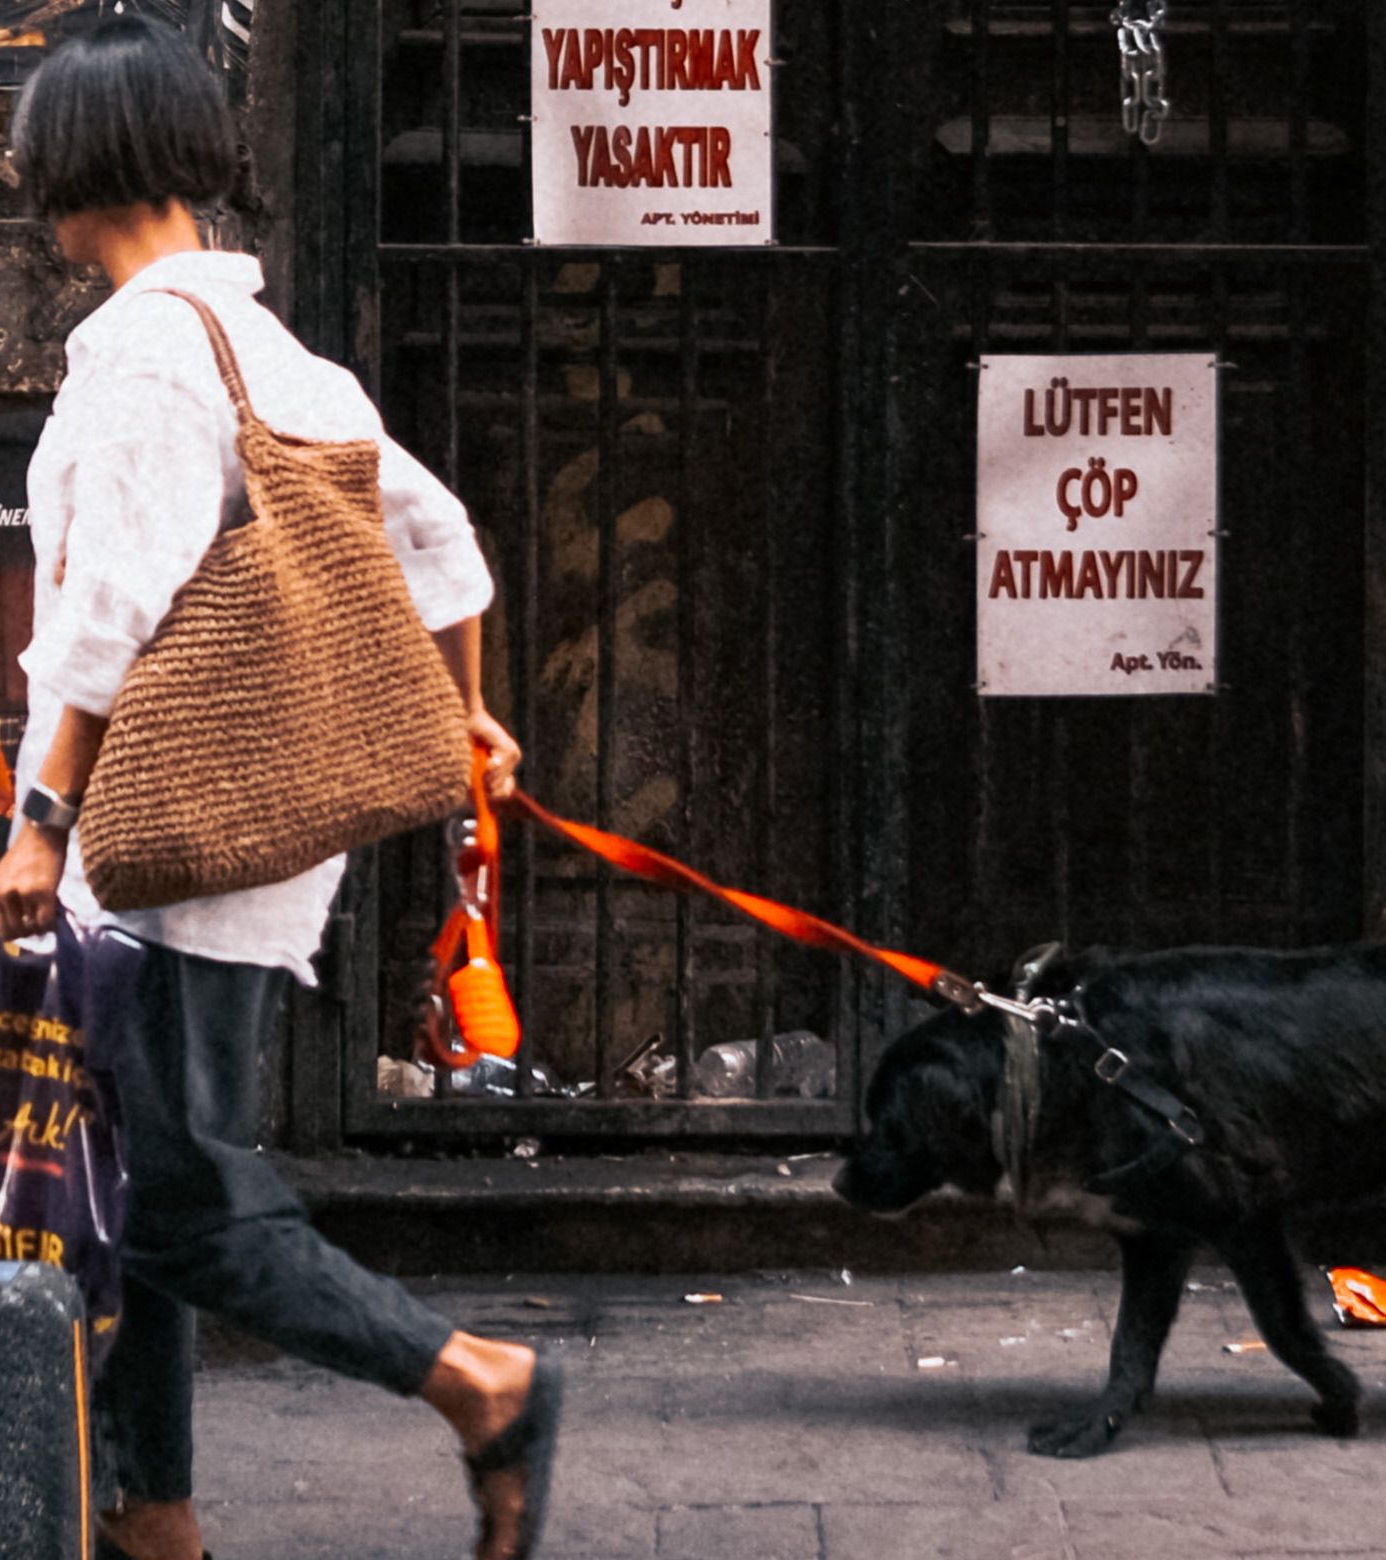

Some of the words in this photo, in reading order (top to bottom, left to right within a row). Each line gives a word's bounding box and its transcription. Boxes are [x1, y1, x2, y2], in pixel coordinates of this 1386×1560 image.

[541, 28, 762, 108] YAPIŞTIRMAK
[570, 125, 733, 189] YASAKTIR
[641, 212, 676, 226] APT.
[683, 210, 760, 225] YÖNETİMİ
[1023, 376, 1173, 437] LÜTFEN
[1056, 456, 1138, 532] ÇÖP
[988, 550, 1204, 600] ATMAYINIZ
[1110, 652, 1153, 675] Apt.
[1157, 651, 1203, 670] Yön.
